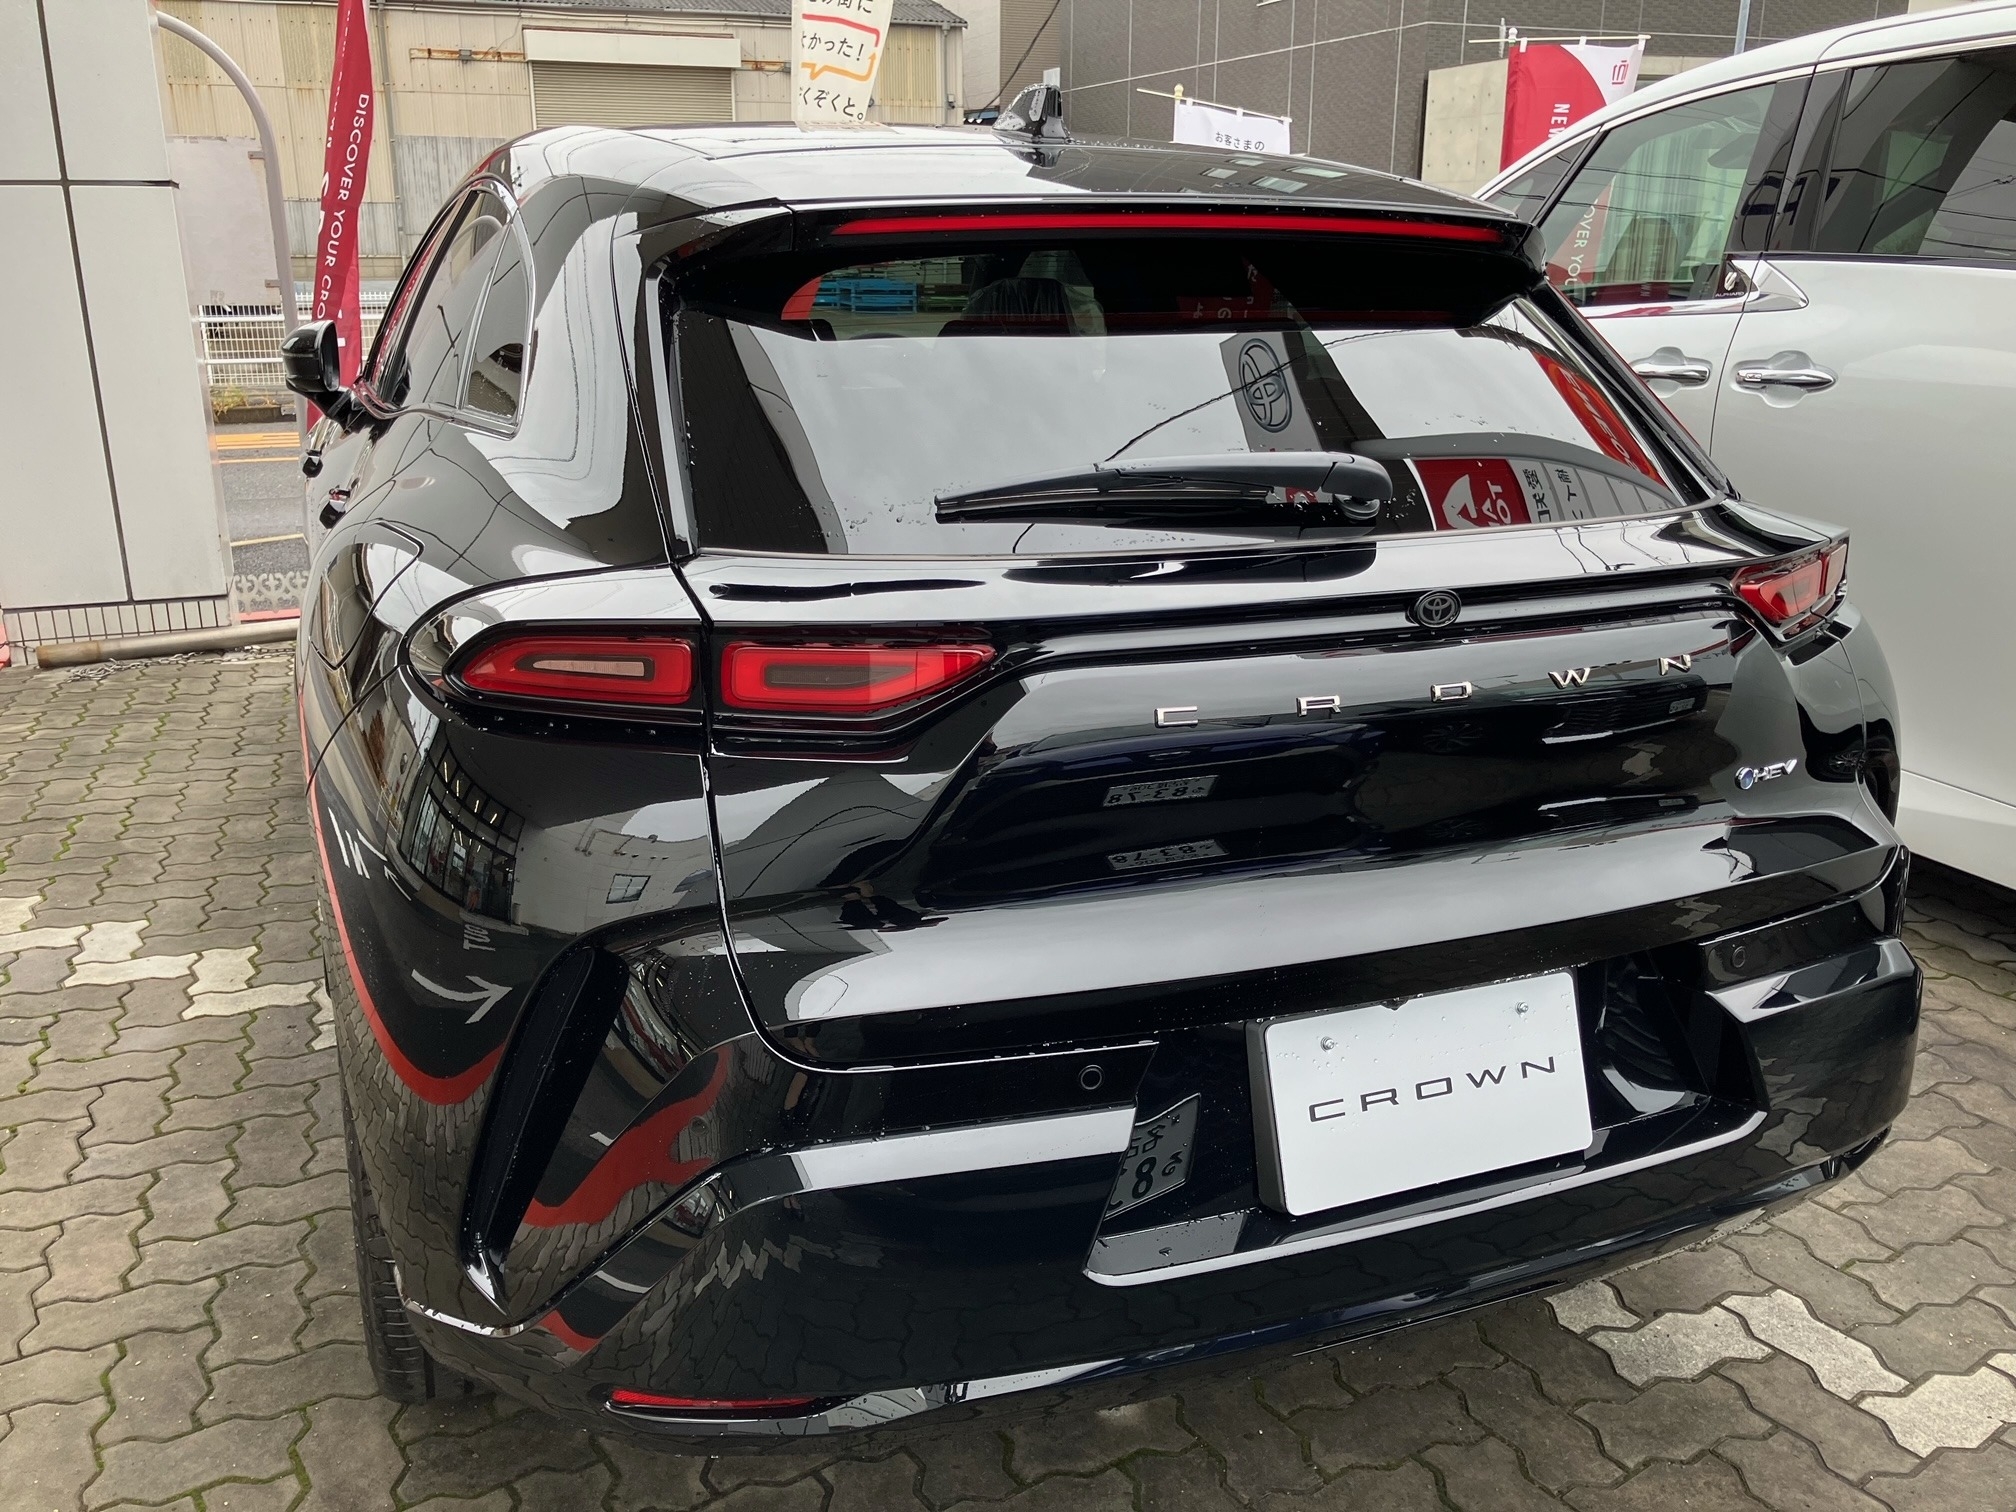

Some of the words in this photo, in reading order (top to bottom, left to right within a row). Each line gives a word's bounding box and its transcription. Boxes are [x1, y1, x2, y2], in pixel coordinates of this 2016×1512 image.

[799, 87, 863, 121] くぞくと。
[337, 93, 370, 201] DISCOVER
[1214, 131, 1265, 152] お客さまの
[324, 208, 346, 268] YOUR
[1574, 198, 1598, 248] OVER
[1153, 654, 1692, 728] CROWN
[1753, 759, 1798, 783] HEV
[1308, 1056, 1556, 1122] CROWN
